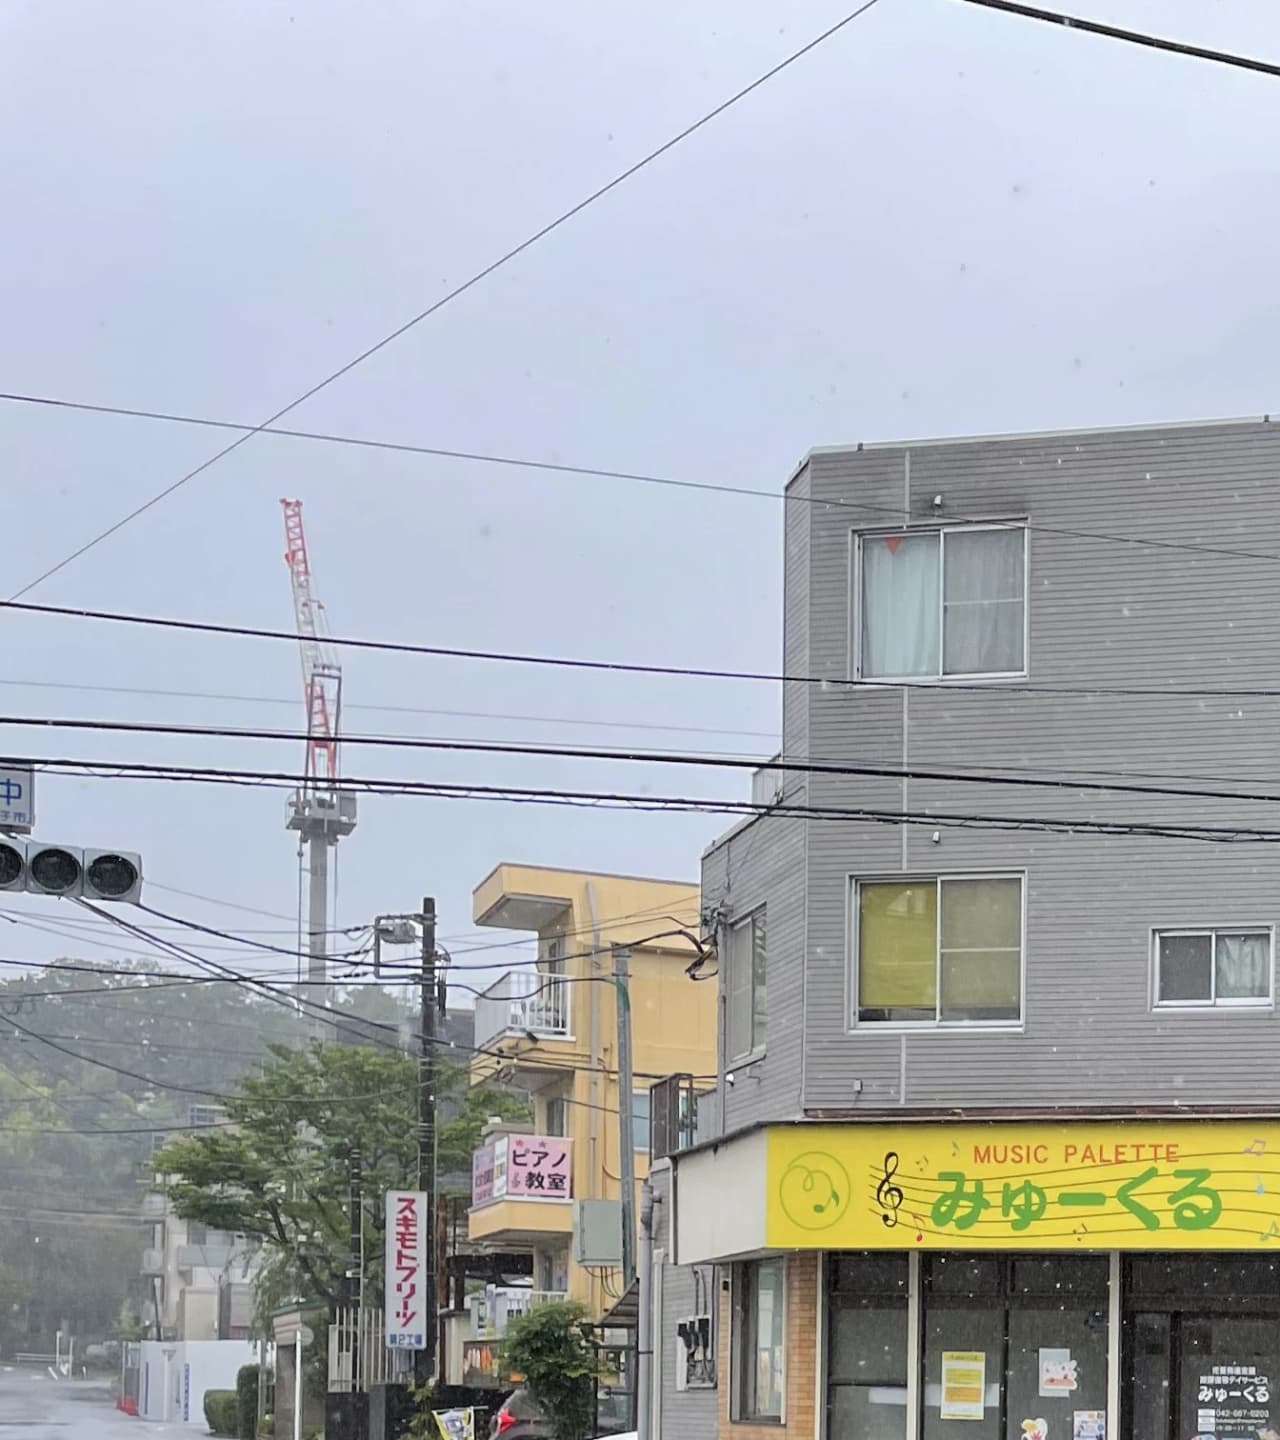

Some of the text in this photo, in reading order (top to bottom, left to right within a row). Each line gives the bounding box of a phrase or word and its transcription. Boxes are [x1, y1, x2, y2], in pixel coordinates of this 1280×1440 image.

[512, 1149, 567, 1169] ピアノ
[973, 1143, 1180, 1164] MUSIC PALETTE
[525, 1171, 567, 1191] 教室
[931, 1166, 1222, 1232] みゅーくる
[1198, 1386, 1270, 1402] みゅーくる
